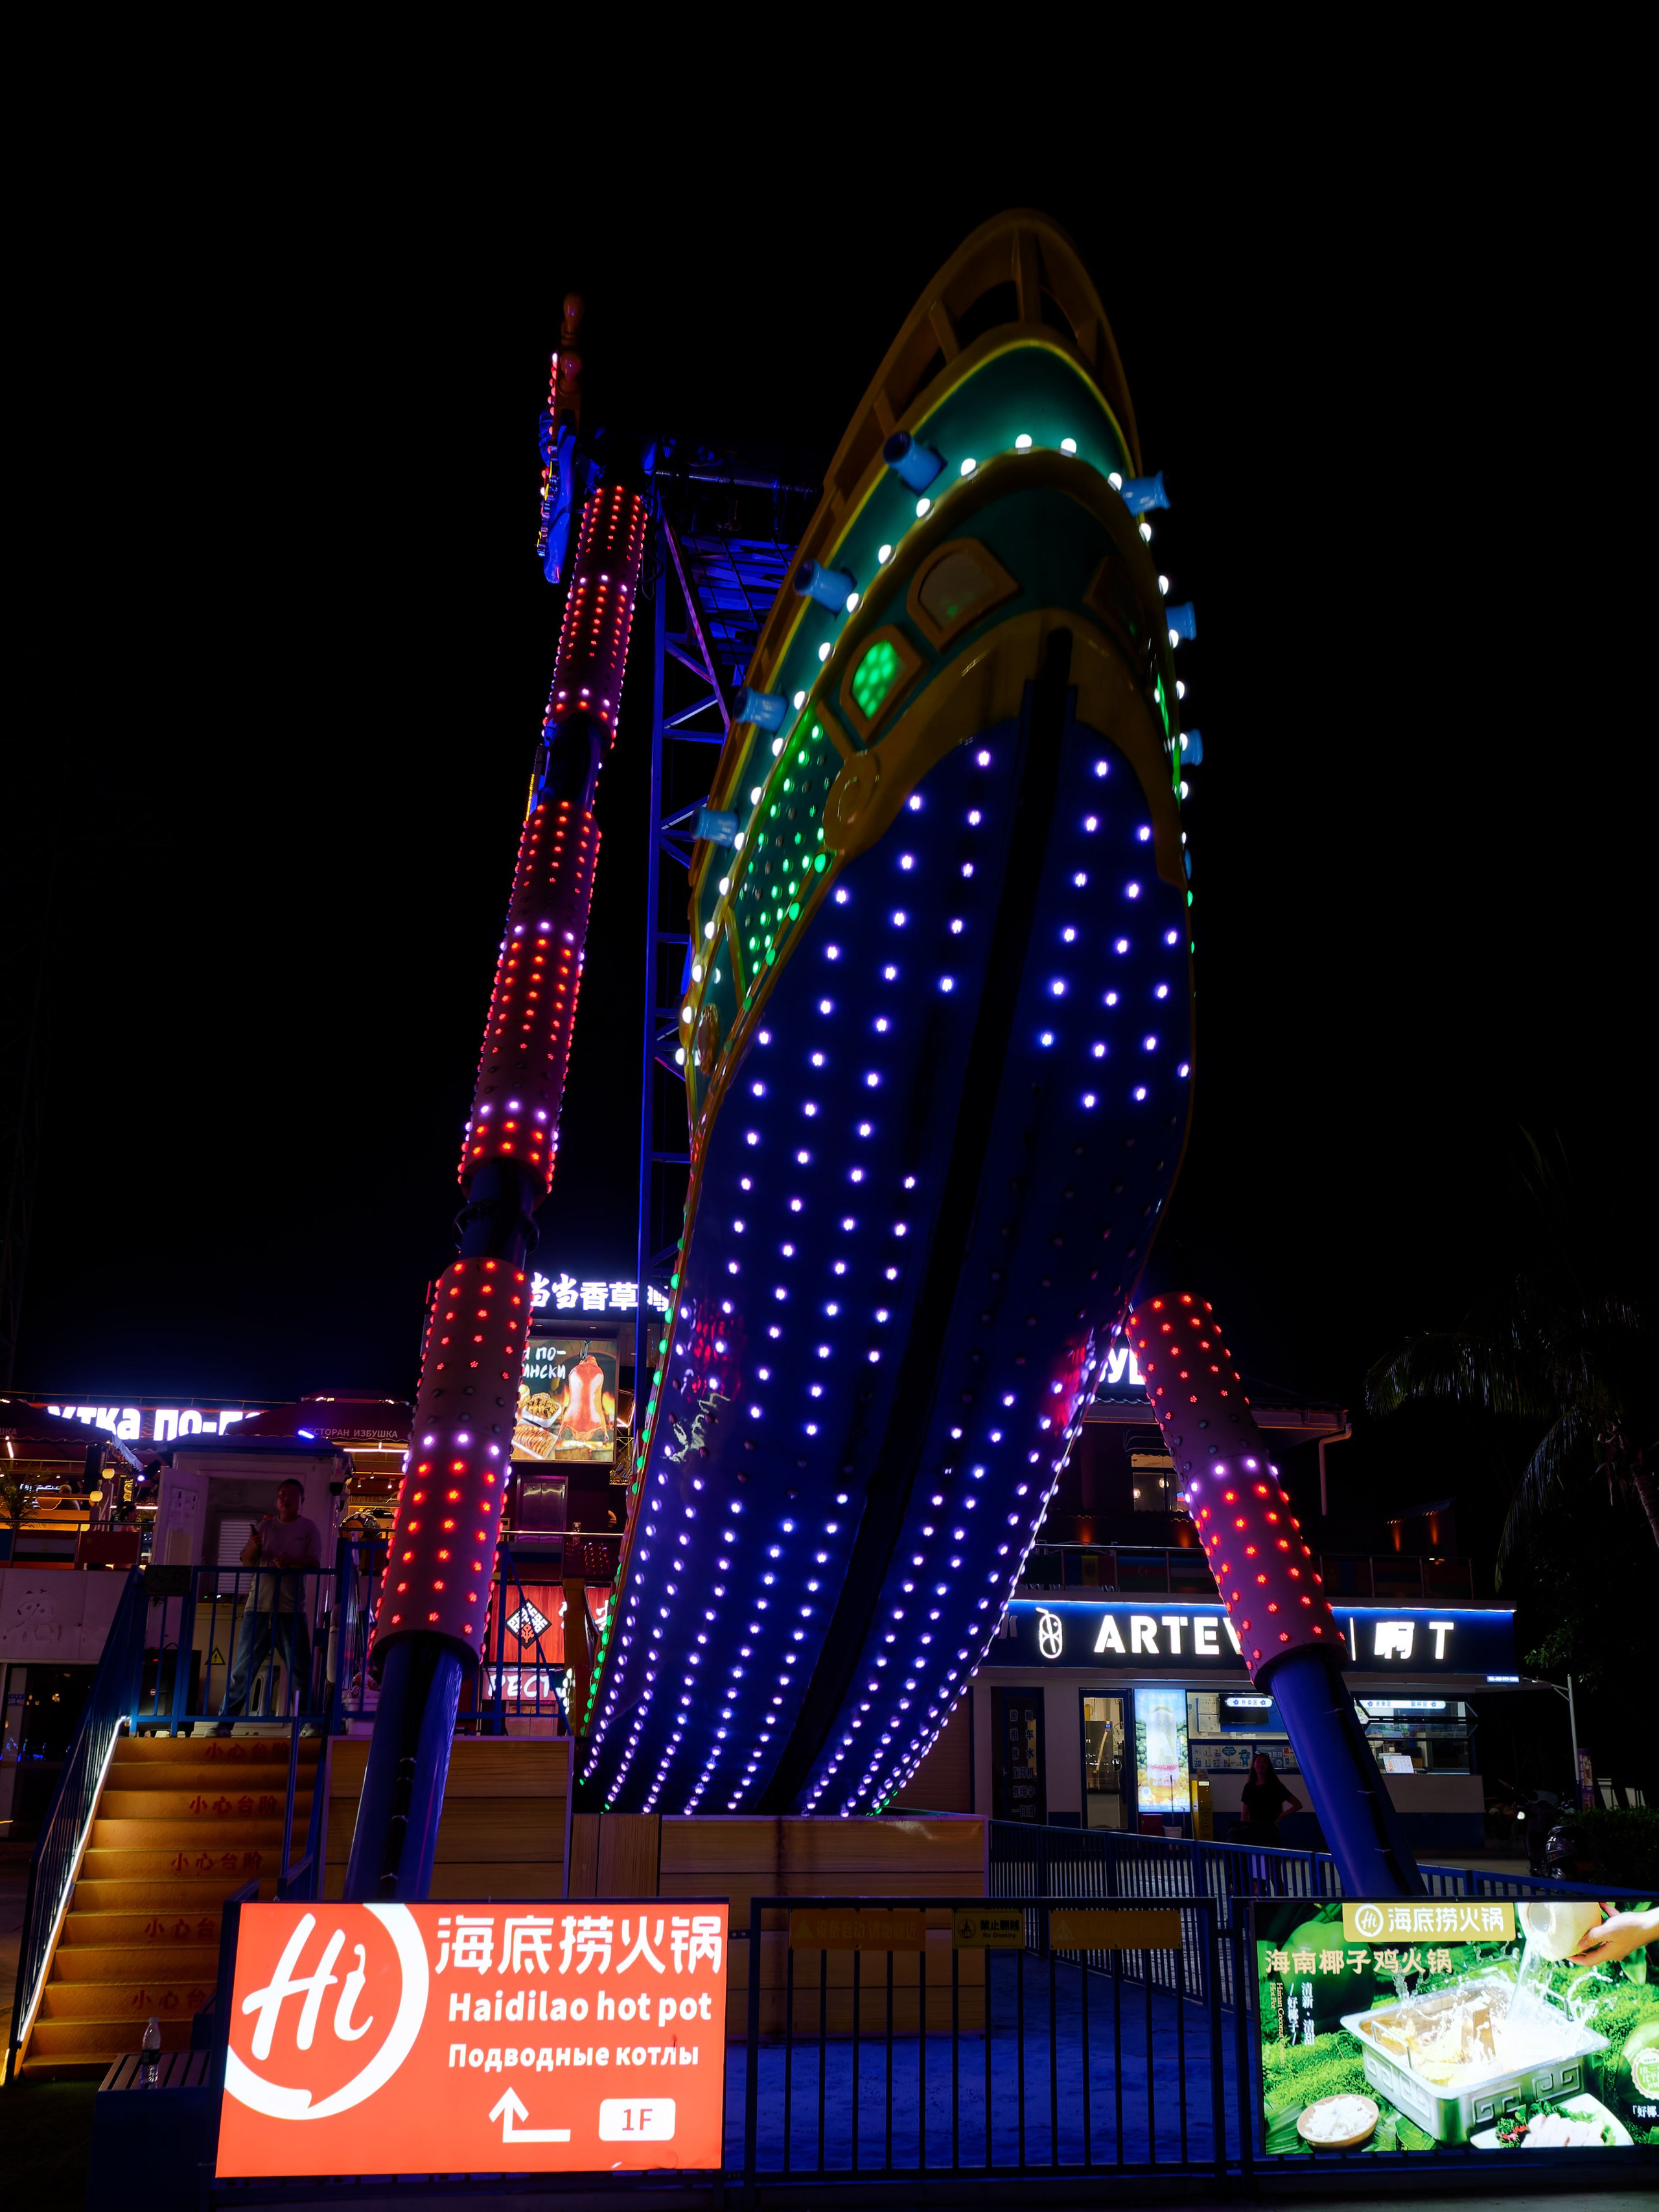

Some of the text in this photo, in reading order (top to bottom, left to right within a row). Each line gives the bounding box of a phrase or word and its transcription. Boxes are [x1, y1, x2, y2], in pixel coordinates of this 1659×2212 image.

[535, 1347, 566, 1361] по-
[354, 1430, 398, 1438] ИЗБУШКА
[189, 1795, 277, 1815] 小心台阶
[171, 1851, 263, 1872] 小心台阶
[979, 1919, 1019, 1931] 禁止翻越
[1387, 1906, 1505, 1934] 海底捞火锅
[435, 1915, 723, 1975] 海底捞火锅
[1265, 1948, 1453, 1975] 海南椰子鸡火锅
[448, 1990, 712, 2027] Haidilao hot pot
[448, 2043, 699, 2073] Подводные котлы
[621, 2108, 653, 2131] 1F
